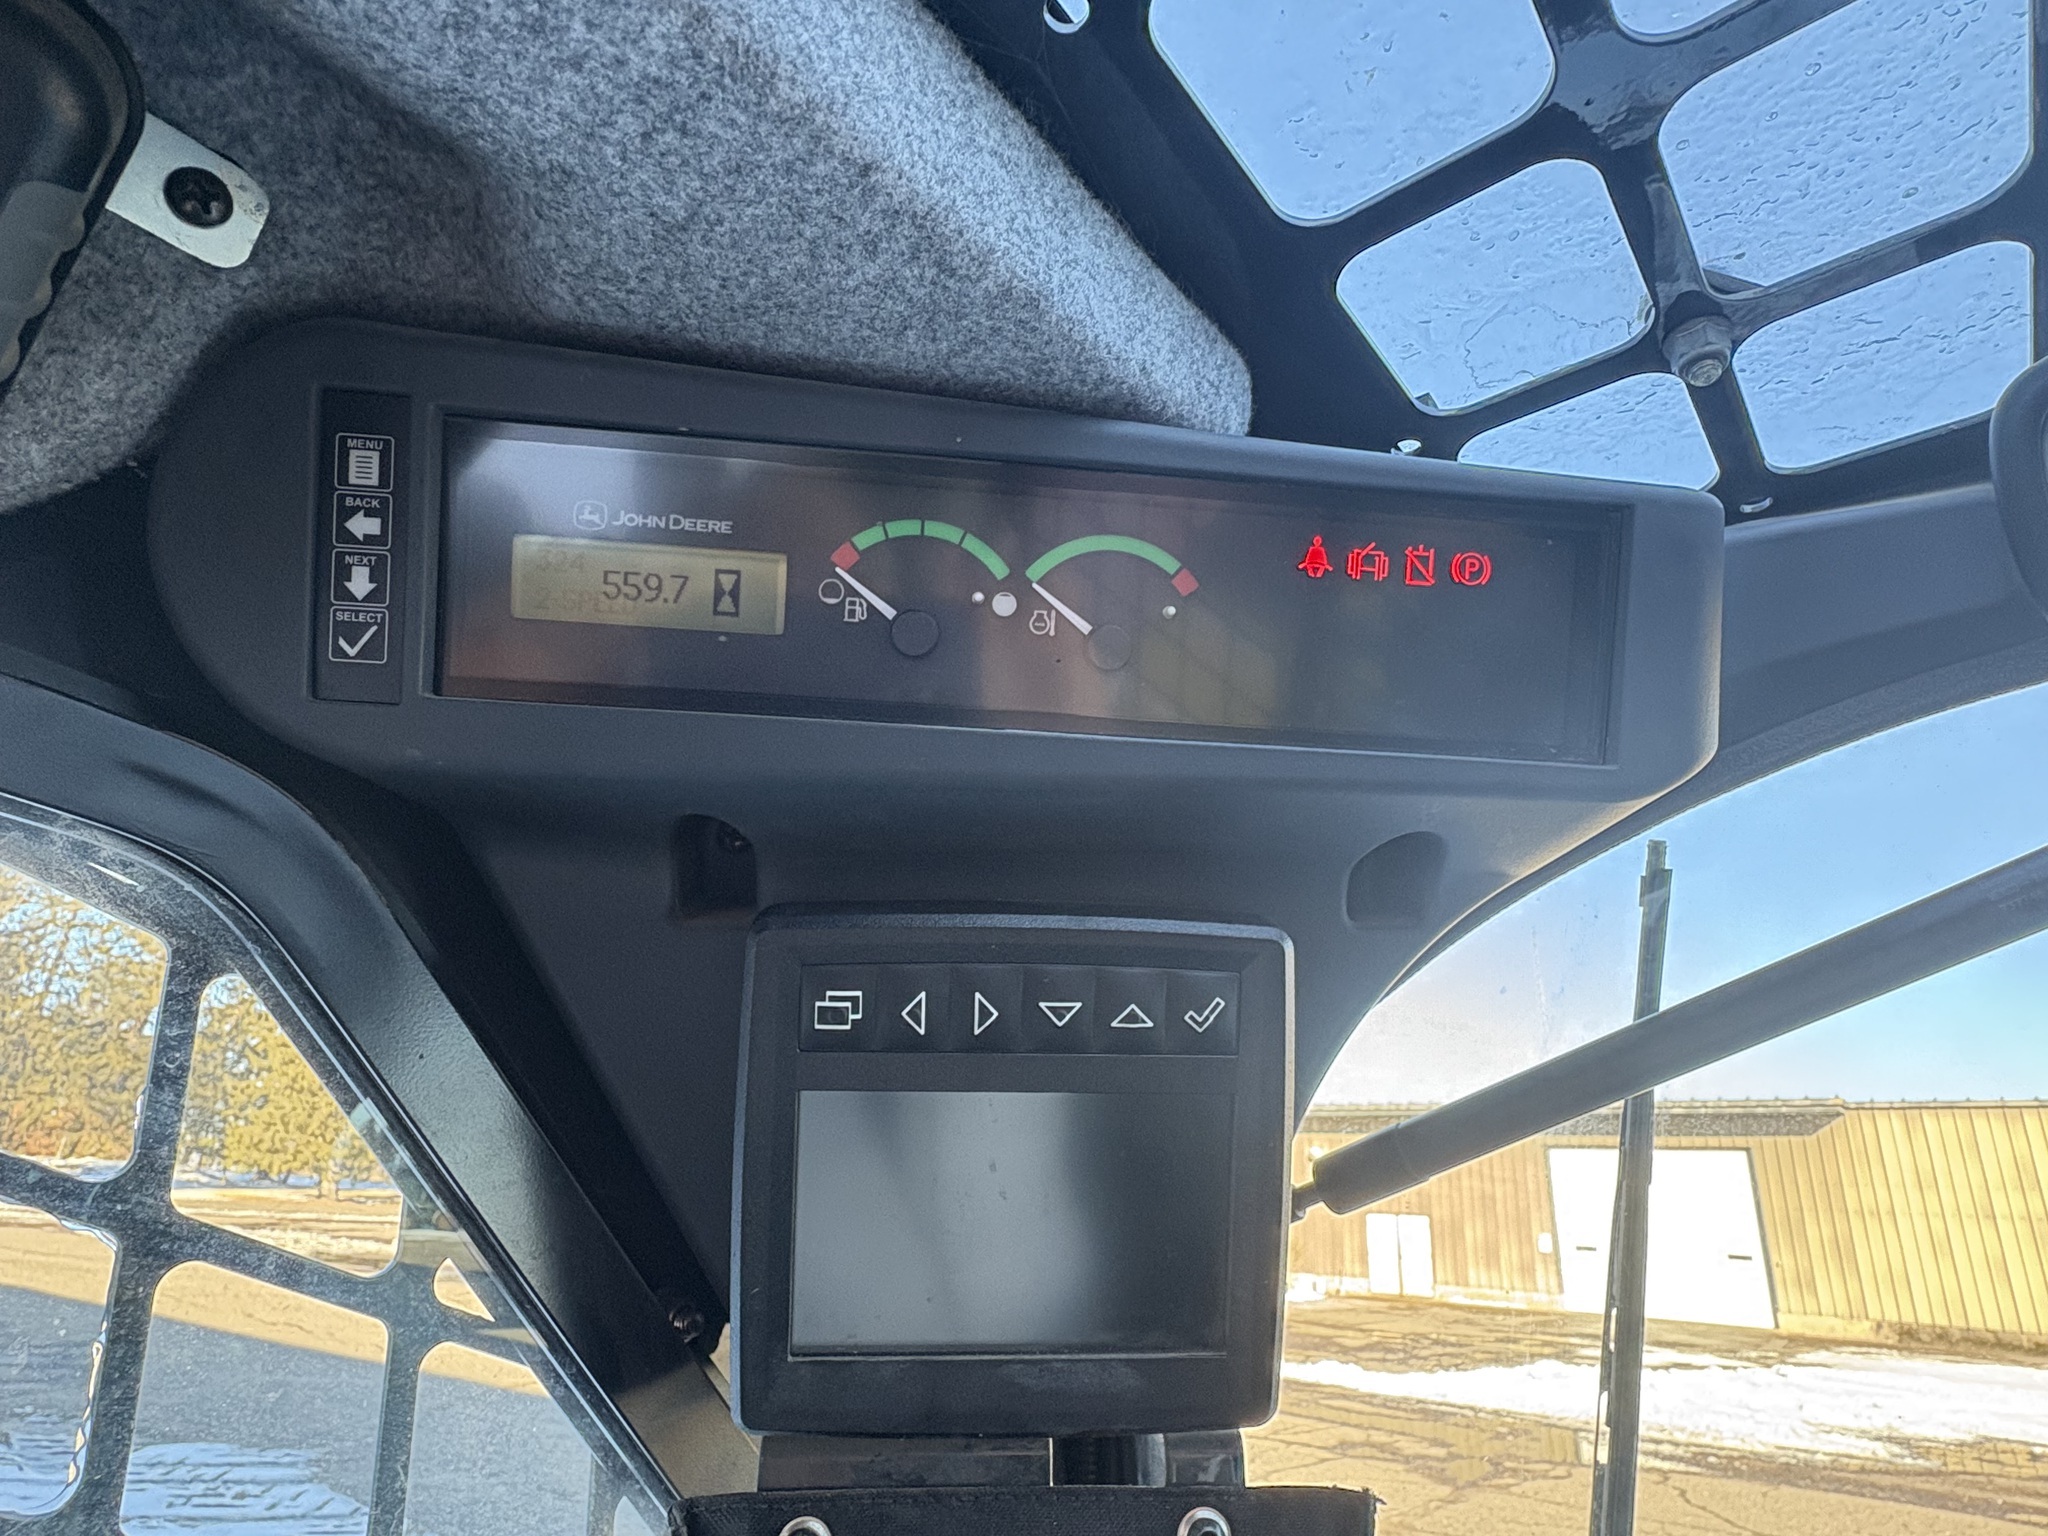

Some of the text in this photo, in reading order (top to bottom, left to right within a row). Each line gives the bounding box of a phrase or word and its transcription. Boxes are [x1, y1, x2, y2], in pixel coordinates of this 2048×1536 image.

[347, 438, 383, 450] MENU
[345, 496, 380, 508] BACK
[612, 510, 733, 534] JOHN DEERE
[344, 555, 377, 567] NEXT
[602, 569, 689, 605] 559.7
[335, 611, 383, 623] SELECT
